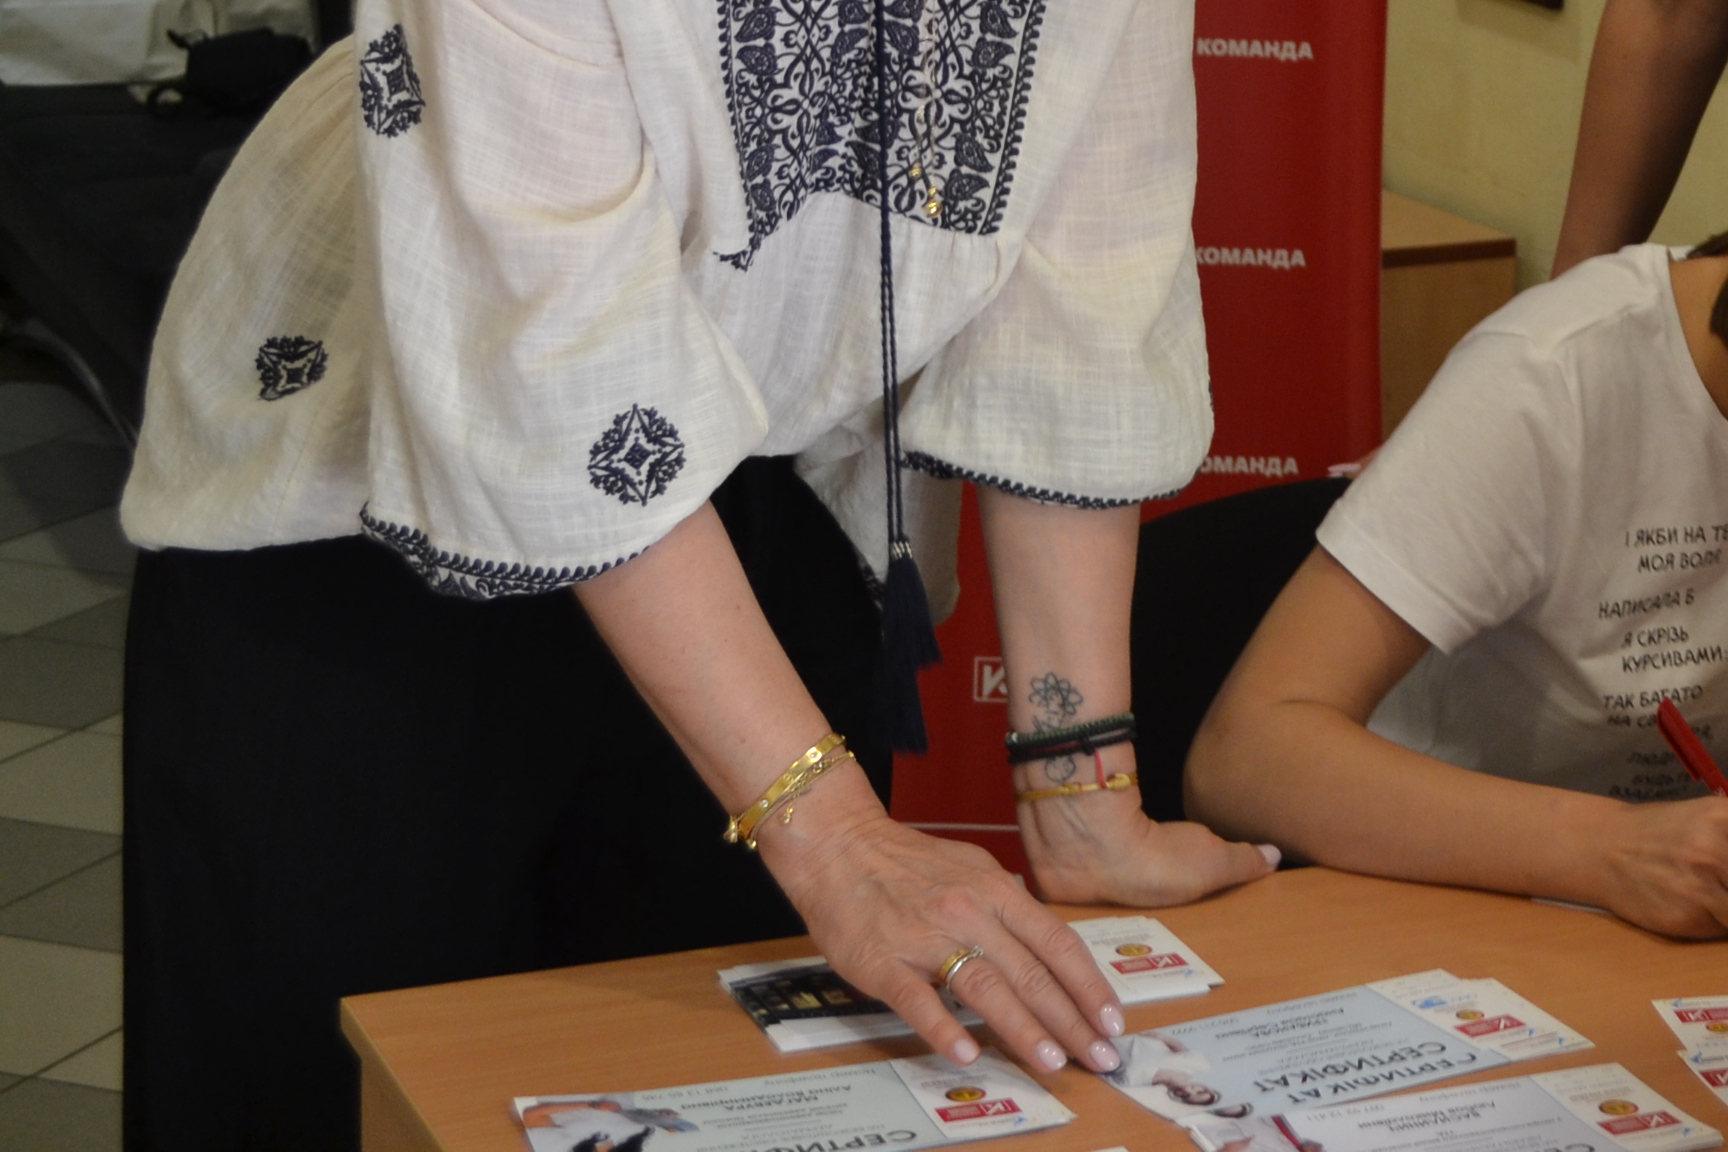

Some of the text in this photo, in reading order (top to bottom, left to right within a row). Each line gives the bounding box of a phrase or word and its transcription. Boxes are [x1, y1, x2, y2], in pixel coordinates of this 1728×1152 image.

[1196, 37, 1314, 62] КОМАНДА
[1200, 455, 1299, 479] ОМАНДА
[1634, 527, 1678, 548] ЯКБИ
[1684, 526, 1706, 543] НА
[1638, 552, 1675, 573] МОЯ
[1598, 588, 1695, 620] НАПИСАЛА Б
[1637, 626, 1690, 647] СКРІЗЬ
[1603, 692, 1635, 709] ТАК
[1252, 1041, 1451, 1093] СЕРТИФІКАТ
